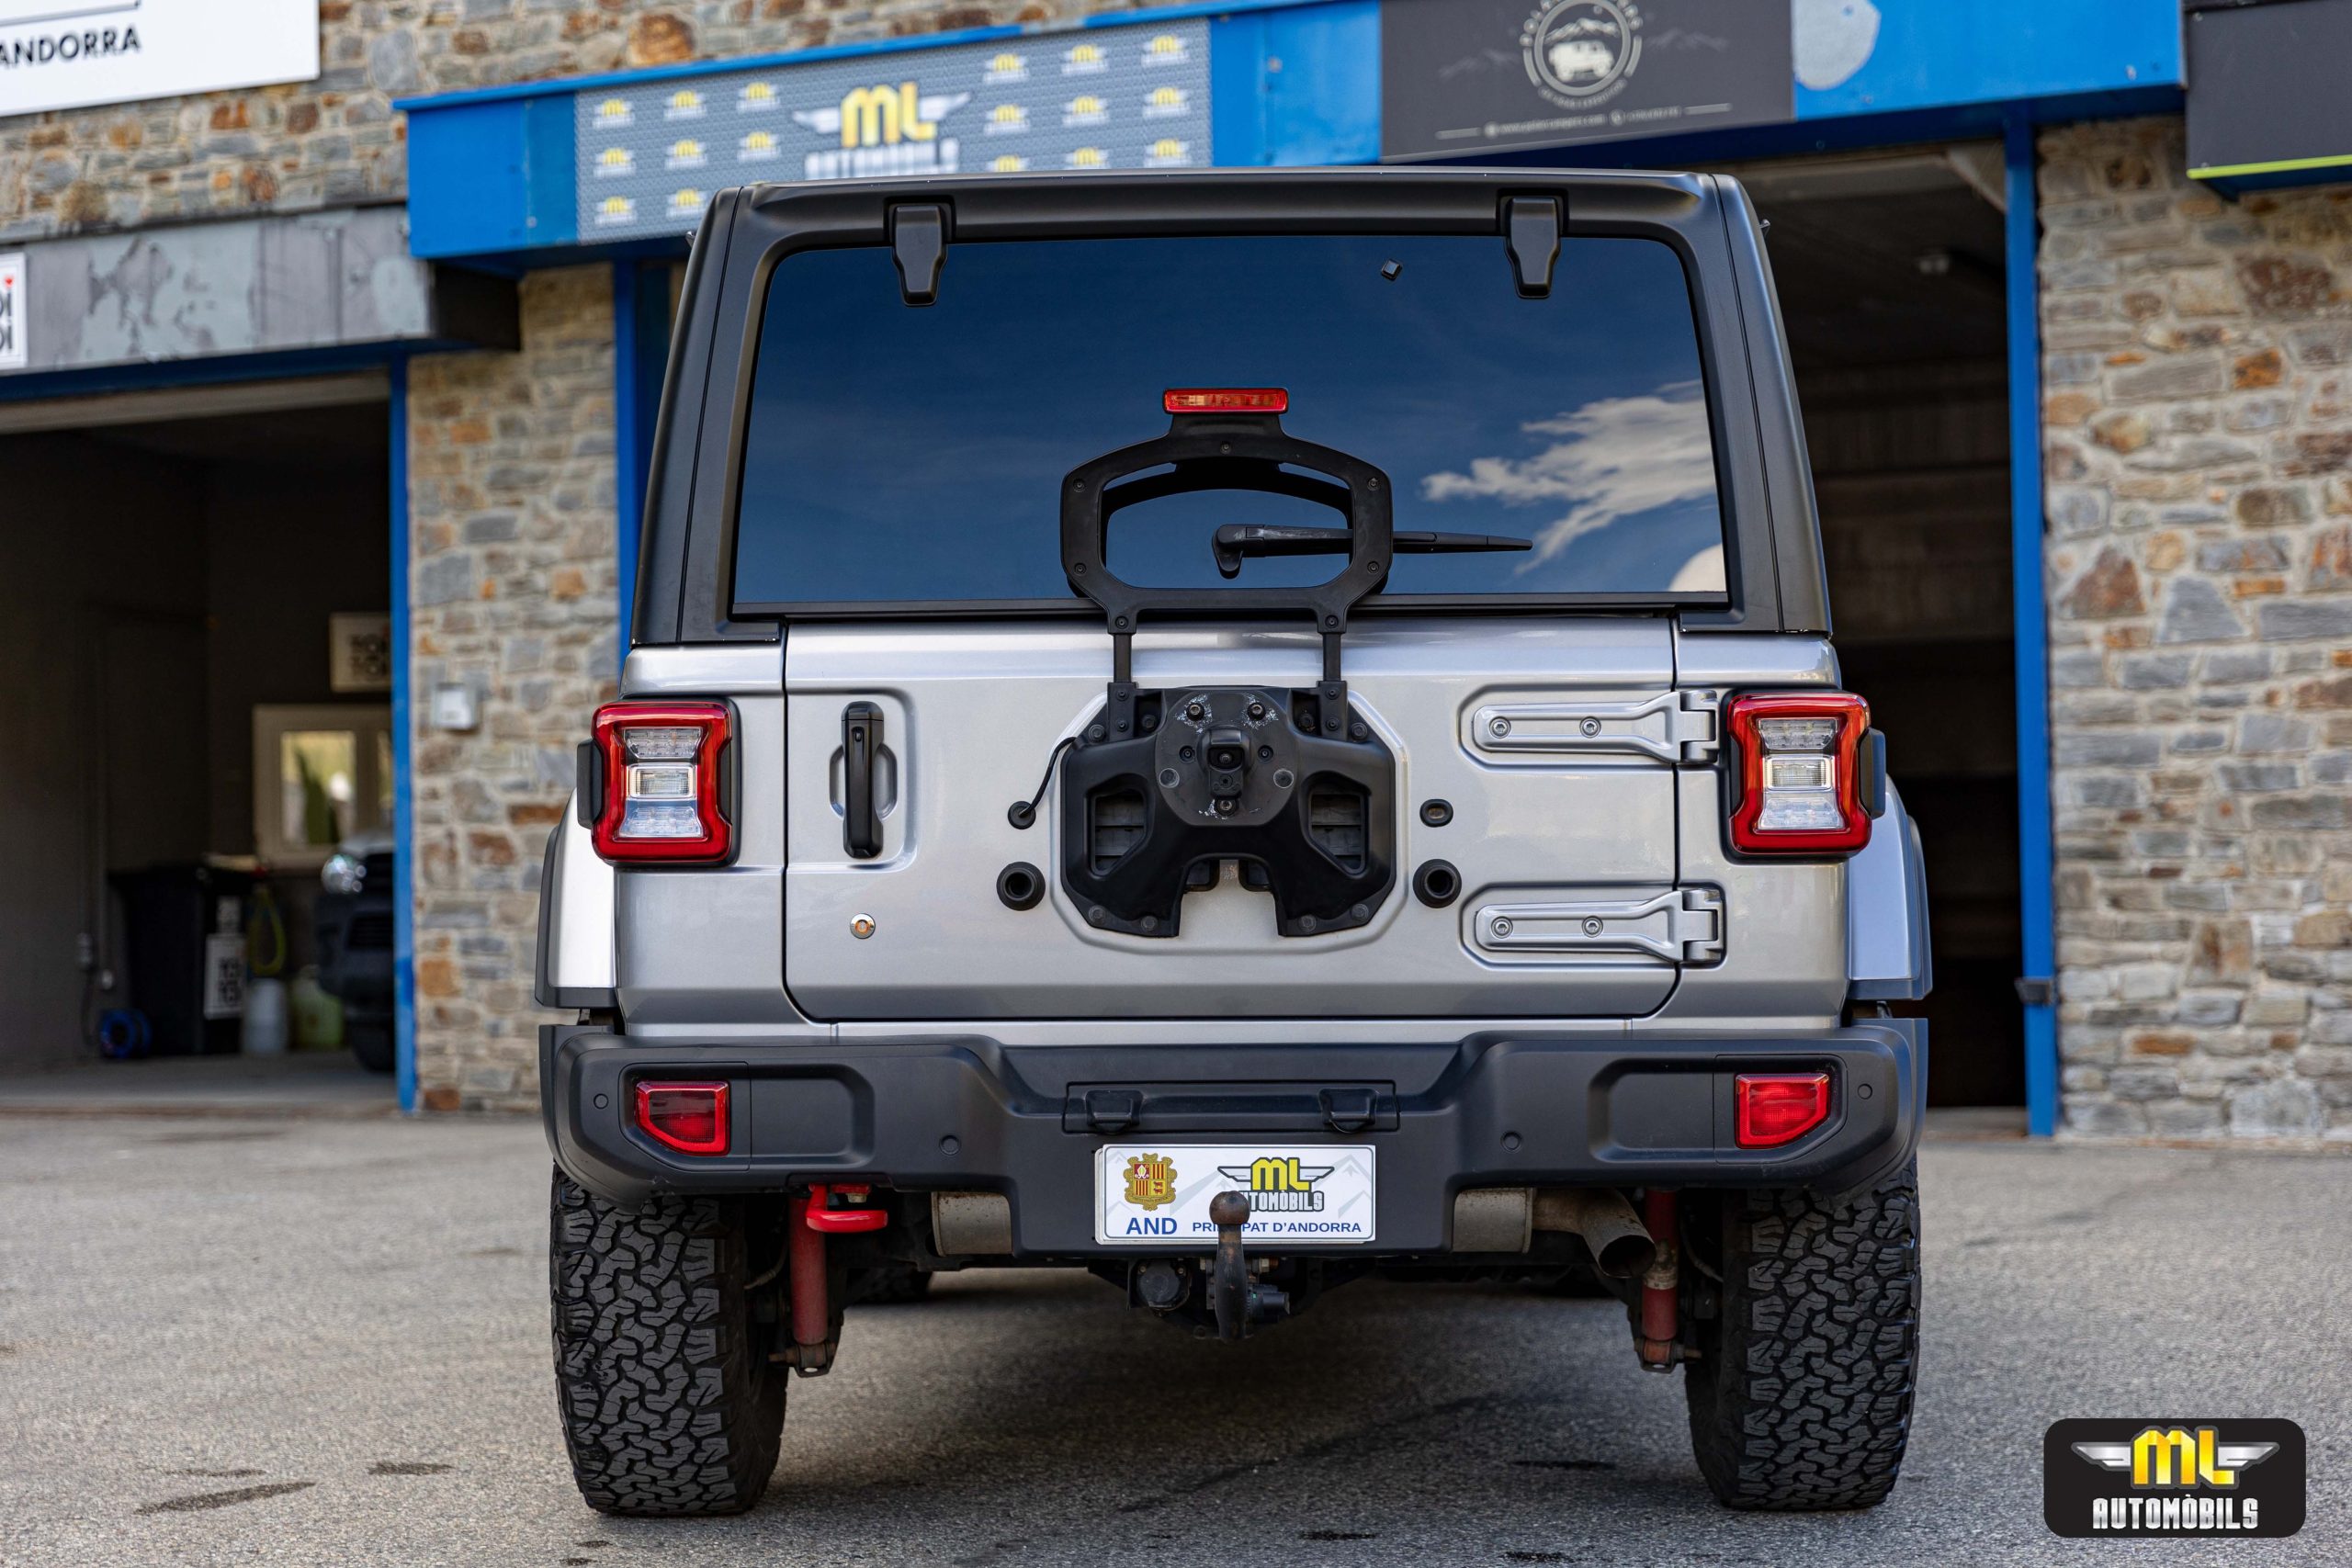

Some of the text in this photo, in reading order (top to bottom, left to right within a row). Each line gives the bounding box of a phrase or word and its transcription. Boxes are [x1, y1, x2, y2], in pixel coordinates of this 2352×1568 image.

[0, 26, 141, 67] ANDORRA
[841, 81, 937, 148] ML
[1250, 1157, 1311, 1191] ML
[1241, 1190, 1324, 1212] TOMÒBILS
[1125, 1217, 1178, 1235] AND
[1193, 1222, 1362, 1233] PRIPAT D'ANDORRA
